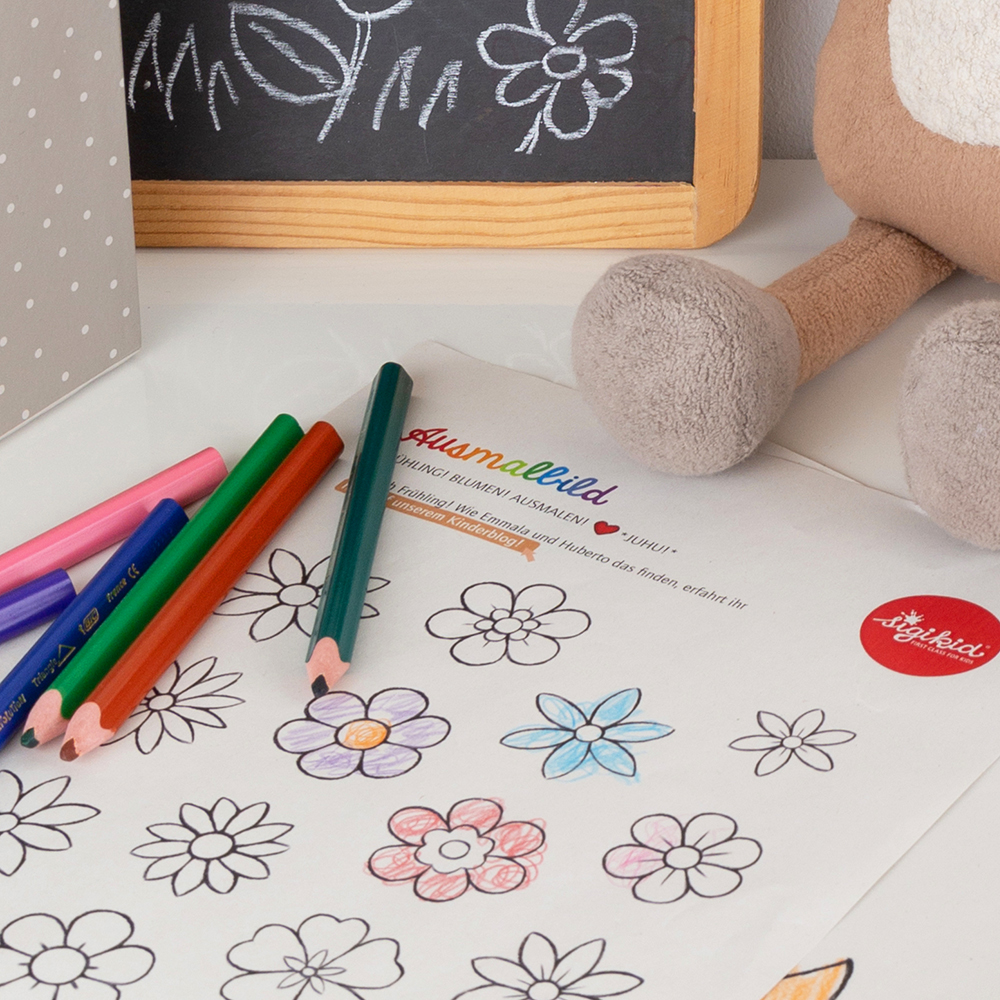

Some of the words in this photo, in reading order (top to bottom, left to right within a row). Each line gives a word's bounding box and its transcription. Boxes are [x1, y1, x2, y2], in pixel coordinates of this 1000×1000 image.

[395, 454, 450, 479] ÜHLING!
[449, 473, 511, 497] BLUMEN!
[509, 494, 590, 527] AUSMALEN!
[400, 428, 619, 506] Ausmalbild
[391, 500, 446, 521] unserem
[446, 516, 525, 548] Kinderblog!
[397, 485, 454, 509] Frühling!
[455, 503, 479, 517] Wie
[480, 512, 531, 536] Emmala
[532, 532, 560, 545] und
[558, 539, 611, 564] Huberto
[611, 559, 636, 573] das
[636, 567, 679, 589] finden,
[682, 583, 728, 605] erfahrt
[727, 597, 749, 610] ihr
[910, 639, 928, 650] FIRST
[927, 645, 946, 656] CLASS
[946, 652, 959, 661] FOR
[959, 656, 974, 665] KIDS
